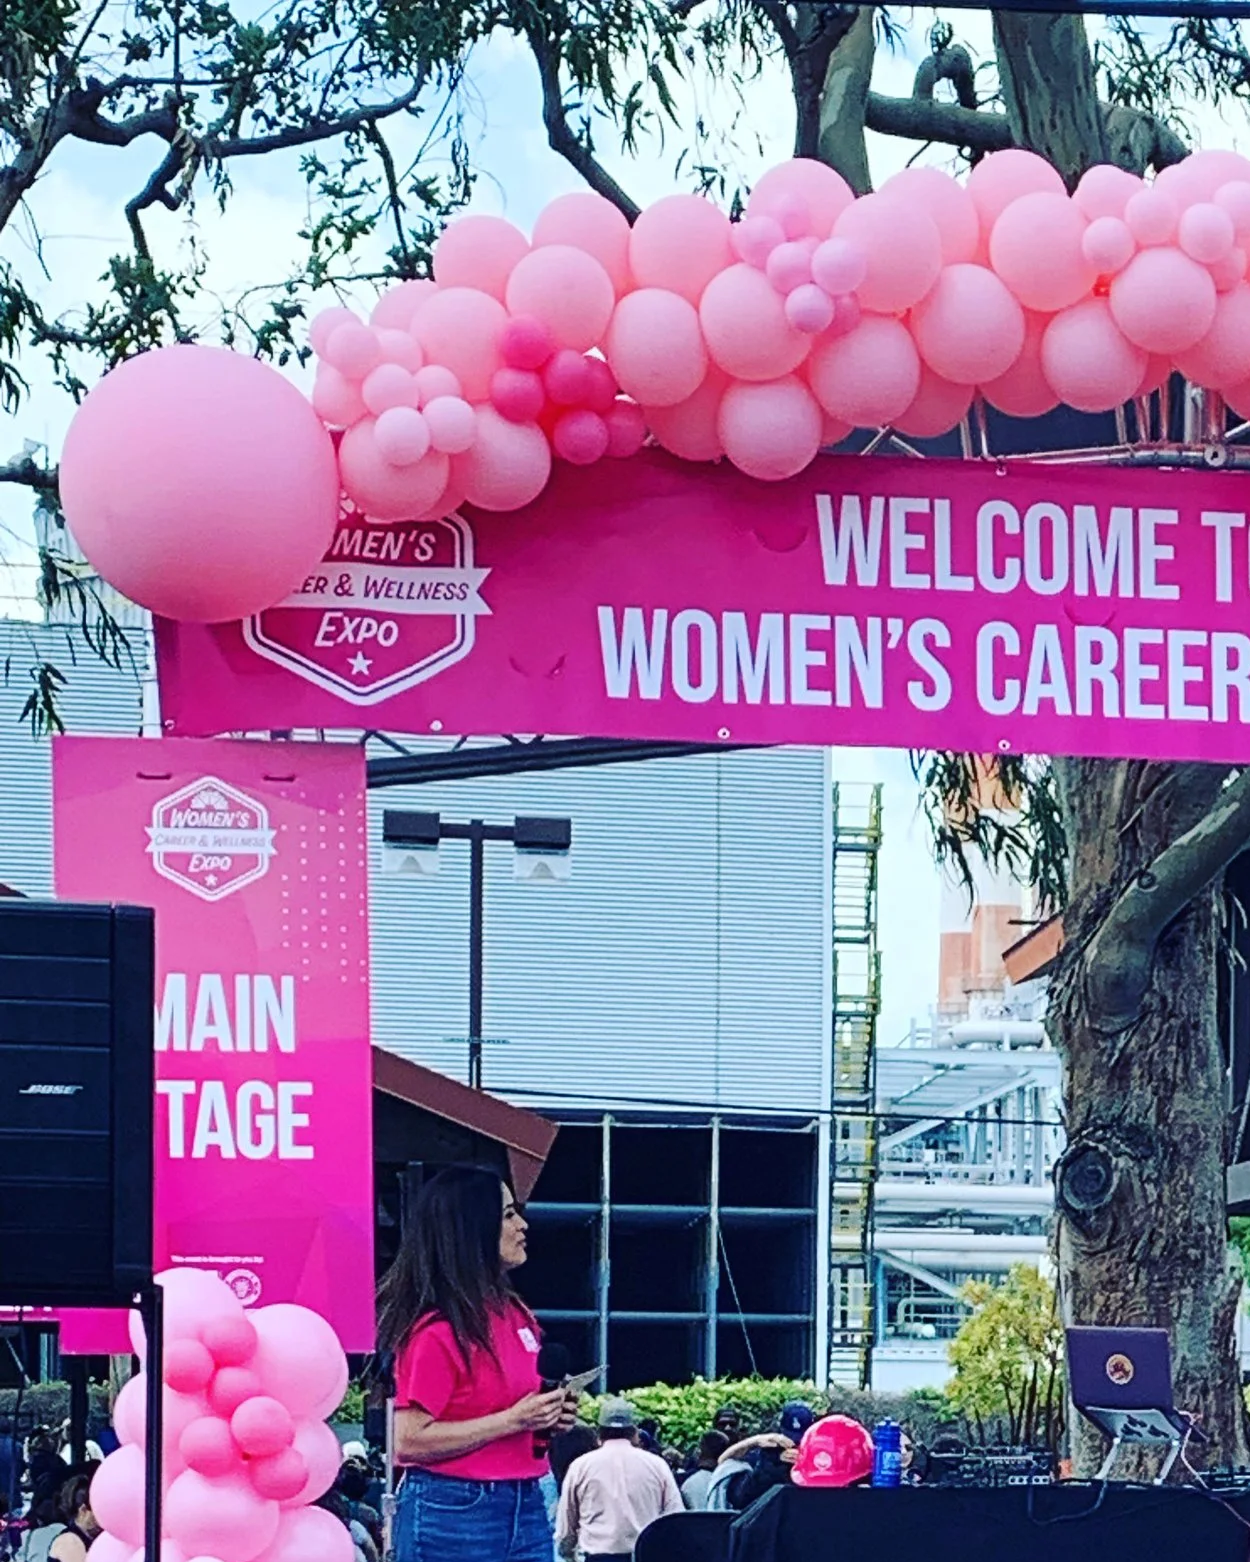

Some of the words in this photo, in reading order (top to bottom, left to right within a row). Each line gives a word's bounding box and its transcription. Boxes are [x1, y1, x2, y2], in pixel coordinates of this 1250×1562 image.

[818, 496, 1179, 599] WELCOME
[333, 574, 354, 598] &
[363, 575, 470, 601] WELLNESS
[314, 611, 399, 647] EXPO
[598, 607, 952, 711] WOMEN'S
[170, 808, 250, 828] WOMEN'S
[188, 853, 233, 873] EXPO
[156, 1080, 314, 1159] TAGE
